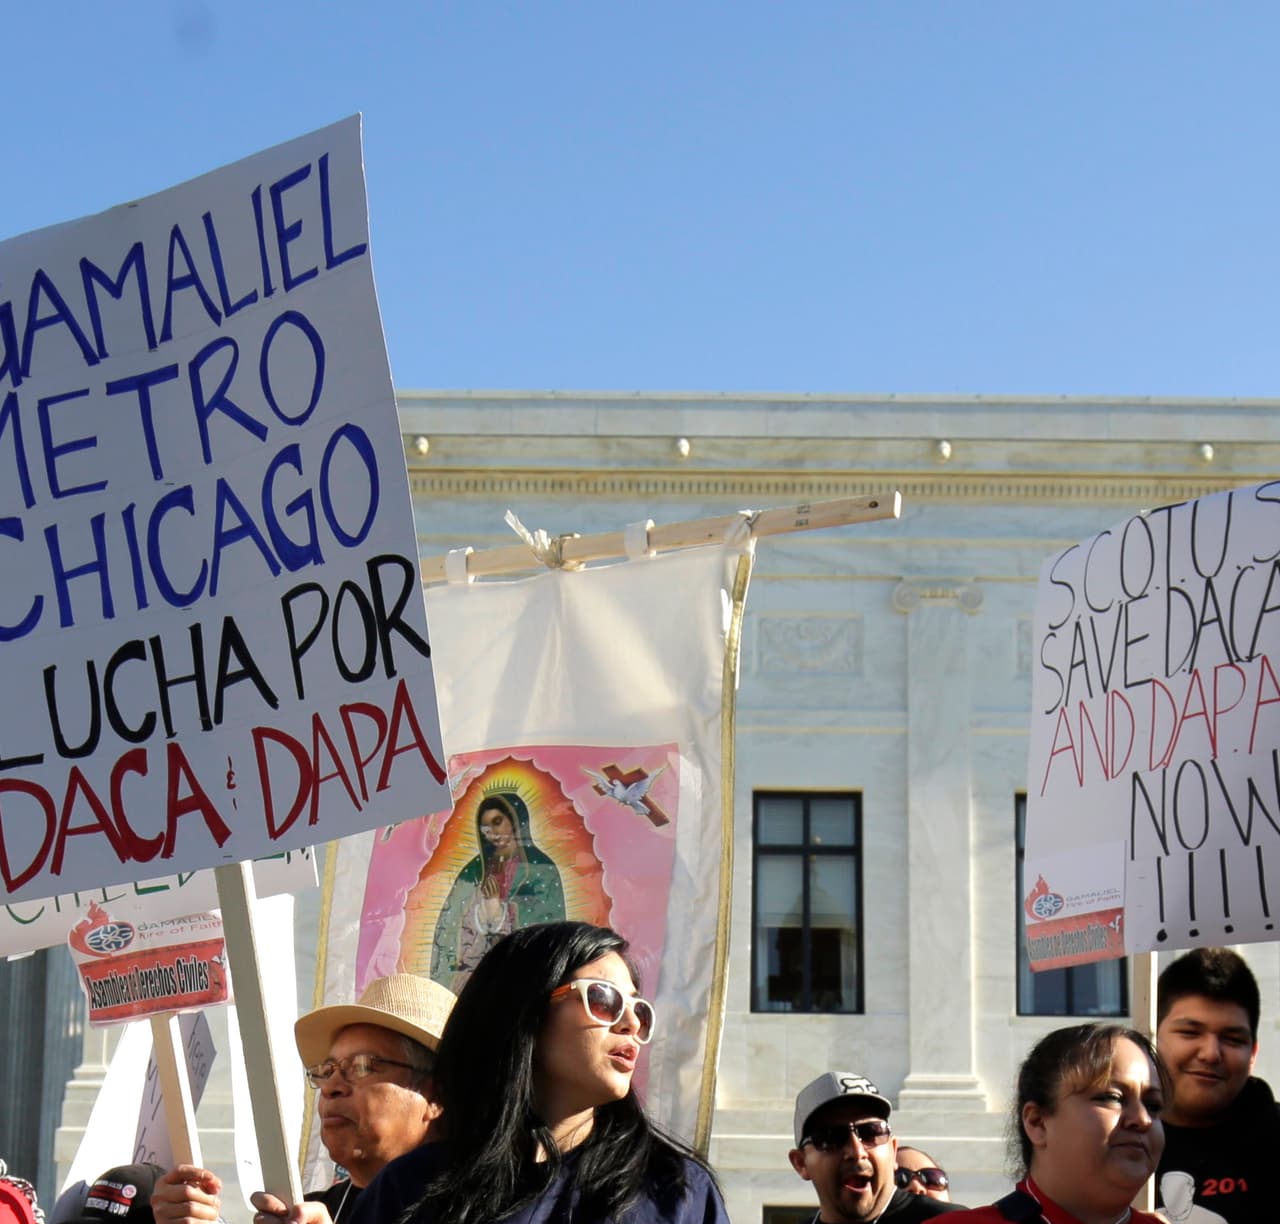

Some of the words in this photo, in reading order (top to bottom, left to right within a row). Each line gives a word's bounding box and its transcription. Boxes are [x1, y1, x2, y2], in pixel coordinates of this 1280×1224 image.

[282, 553, 431, 701] POR
[1041, 600, 1153, 715] SAVE
[251, 679, 448, 842] DAPA
[1041, 689, 1135, 797] AND
[86, 968, 130, 1009] Asamblea
[176, 954, 209, 995] Civiles
